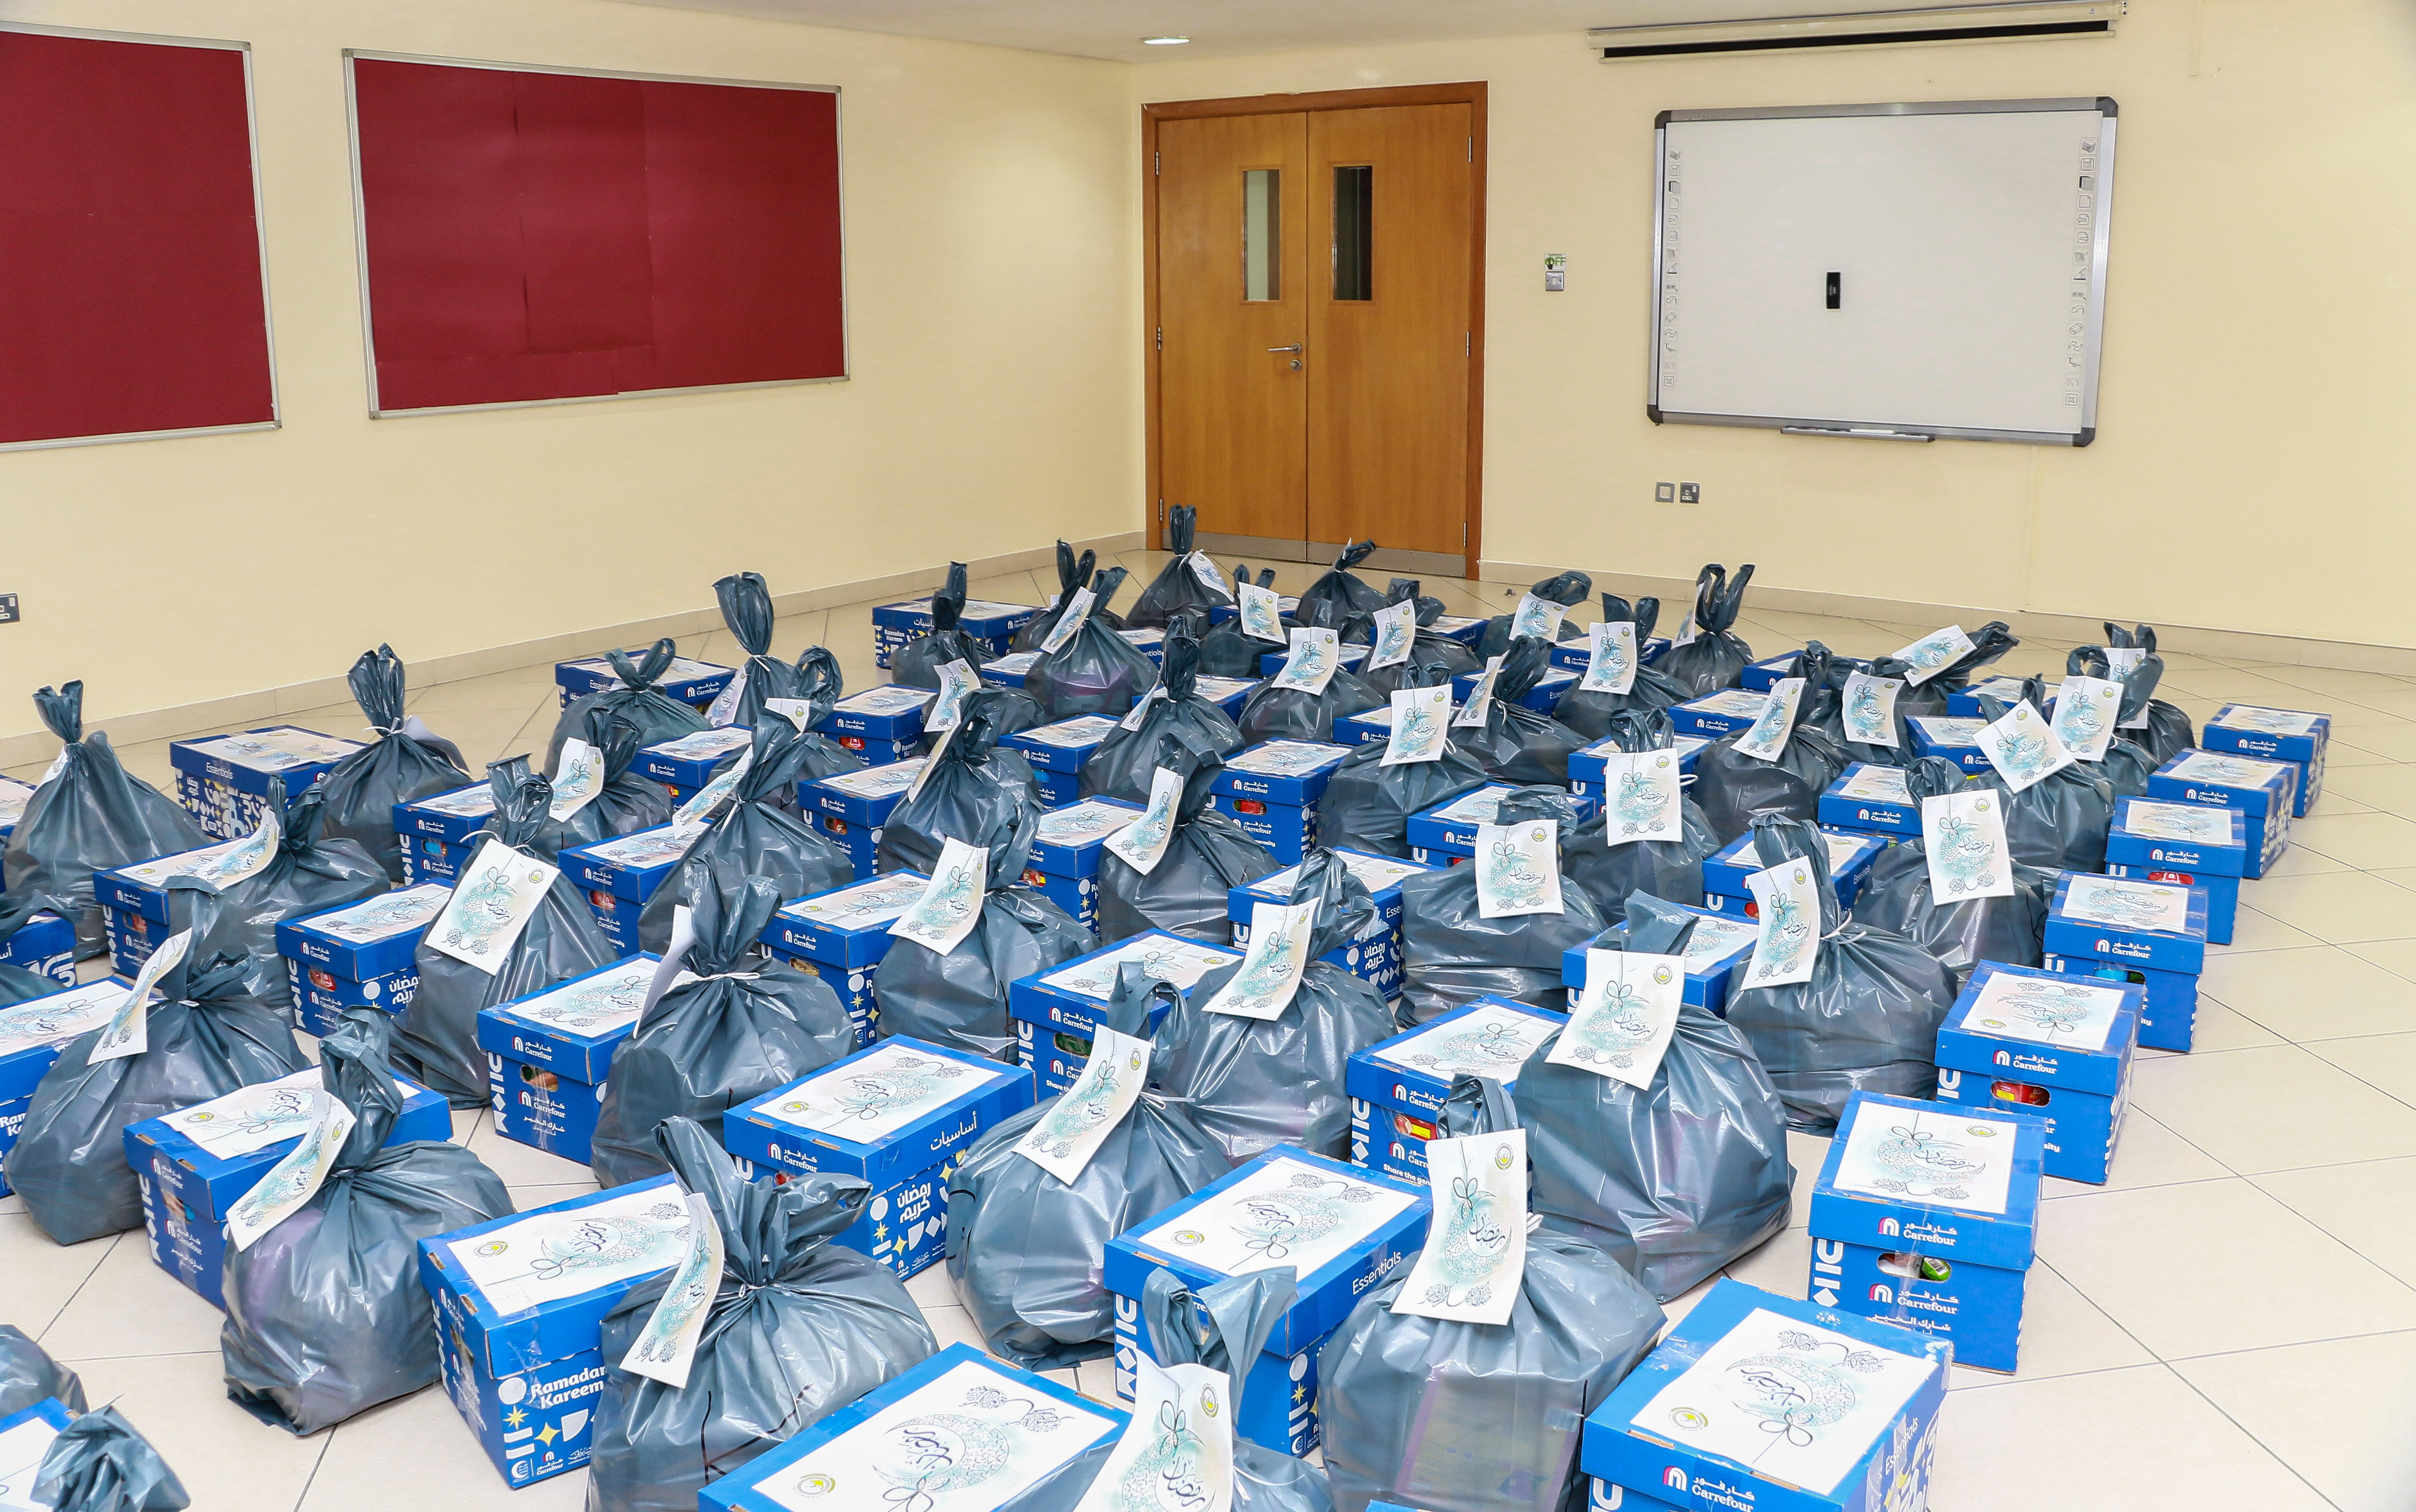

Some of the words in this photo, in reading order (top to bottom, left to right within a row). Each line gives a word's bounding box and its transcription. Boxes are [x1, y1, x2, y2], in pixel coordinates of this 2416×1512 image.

[884, 629, 904, 638] Ramadan
[590, 680, 611, 691] Essentia
[206, 762, 233, 780] Essentials
[2198, 796, 2227, 804] Carrefour
[828, 803, 845, 813] Carrefour
[1871, 815, 1900, 824] Carrefour
[426, 826, 445, 834] Carrefour
[1254, 838, 1276, 848] nerosity
[2165, 856, 2198, 865] Carrefour
[430, 865, 453, 875] Carrefour
[593, 874, 612, 886] Carrefour
[598, 921, 620, 933] Carrefour
[607, 937, 625, 948] erosity
[794, 934, 816, 943] كارفور
[794, 939, 816, 950] Carrefour
[310, 946, 329, 954] كارفور
[2112, 947, 2150, 958] Carrefour
[2113, 942, 2151, 951] كارفور
[310, 950, 330, 962] Carrefour
[1365, 954, 1384, 971] كريم
[1063, 1012, 1093, 1024] كارفور
[1063, 1017, 1093, 1032] Carrefour
[525, 1041, 552, 1052] كارفور
[525, 1045, 552, 1060] Carrefour
[2014, 1054, 2057, 1065] كارفور
[2013, 1060, 2057, 1074] Carrefour
[1046, 1080, 1063, 1090] Share
[533, 1096, 565, 1109] كارفور
[1409, 1090, 1444, 1103] كارفور
[534, 1102, 565, 1117] Carrefour
[1409, 1096, 1439, 1112] Carrefo
[930, 1111, 977, 1152] أساسيات
[784, 1149, 817, 1163] كارفور
[1408, 1156, 1429, 1168] Carre
[783, 1154, 818, 1173] Carrefour
[1383, 1164, 1403, 1176] Share
[899, 1200, 931, 1224] كريم
[1903, 1221, 1957, 1236] كارفور
[1903, 1229, 1956, 1246] Carrefour
[1352, 1251, 1401, 1295] Essentials
[1899, 1290, 1958, 1303] كارفور
[1898, 1296, 1958, 1315] Carrefour
[540, 1381, 604, 1409] Kareem
[537, 1463, 563, 1475] Carrefour
[1693, 1476, 1755, 1501] كارفور
[1691, 1484, 1754, 1512] Carrefour
